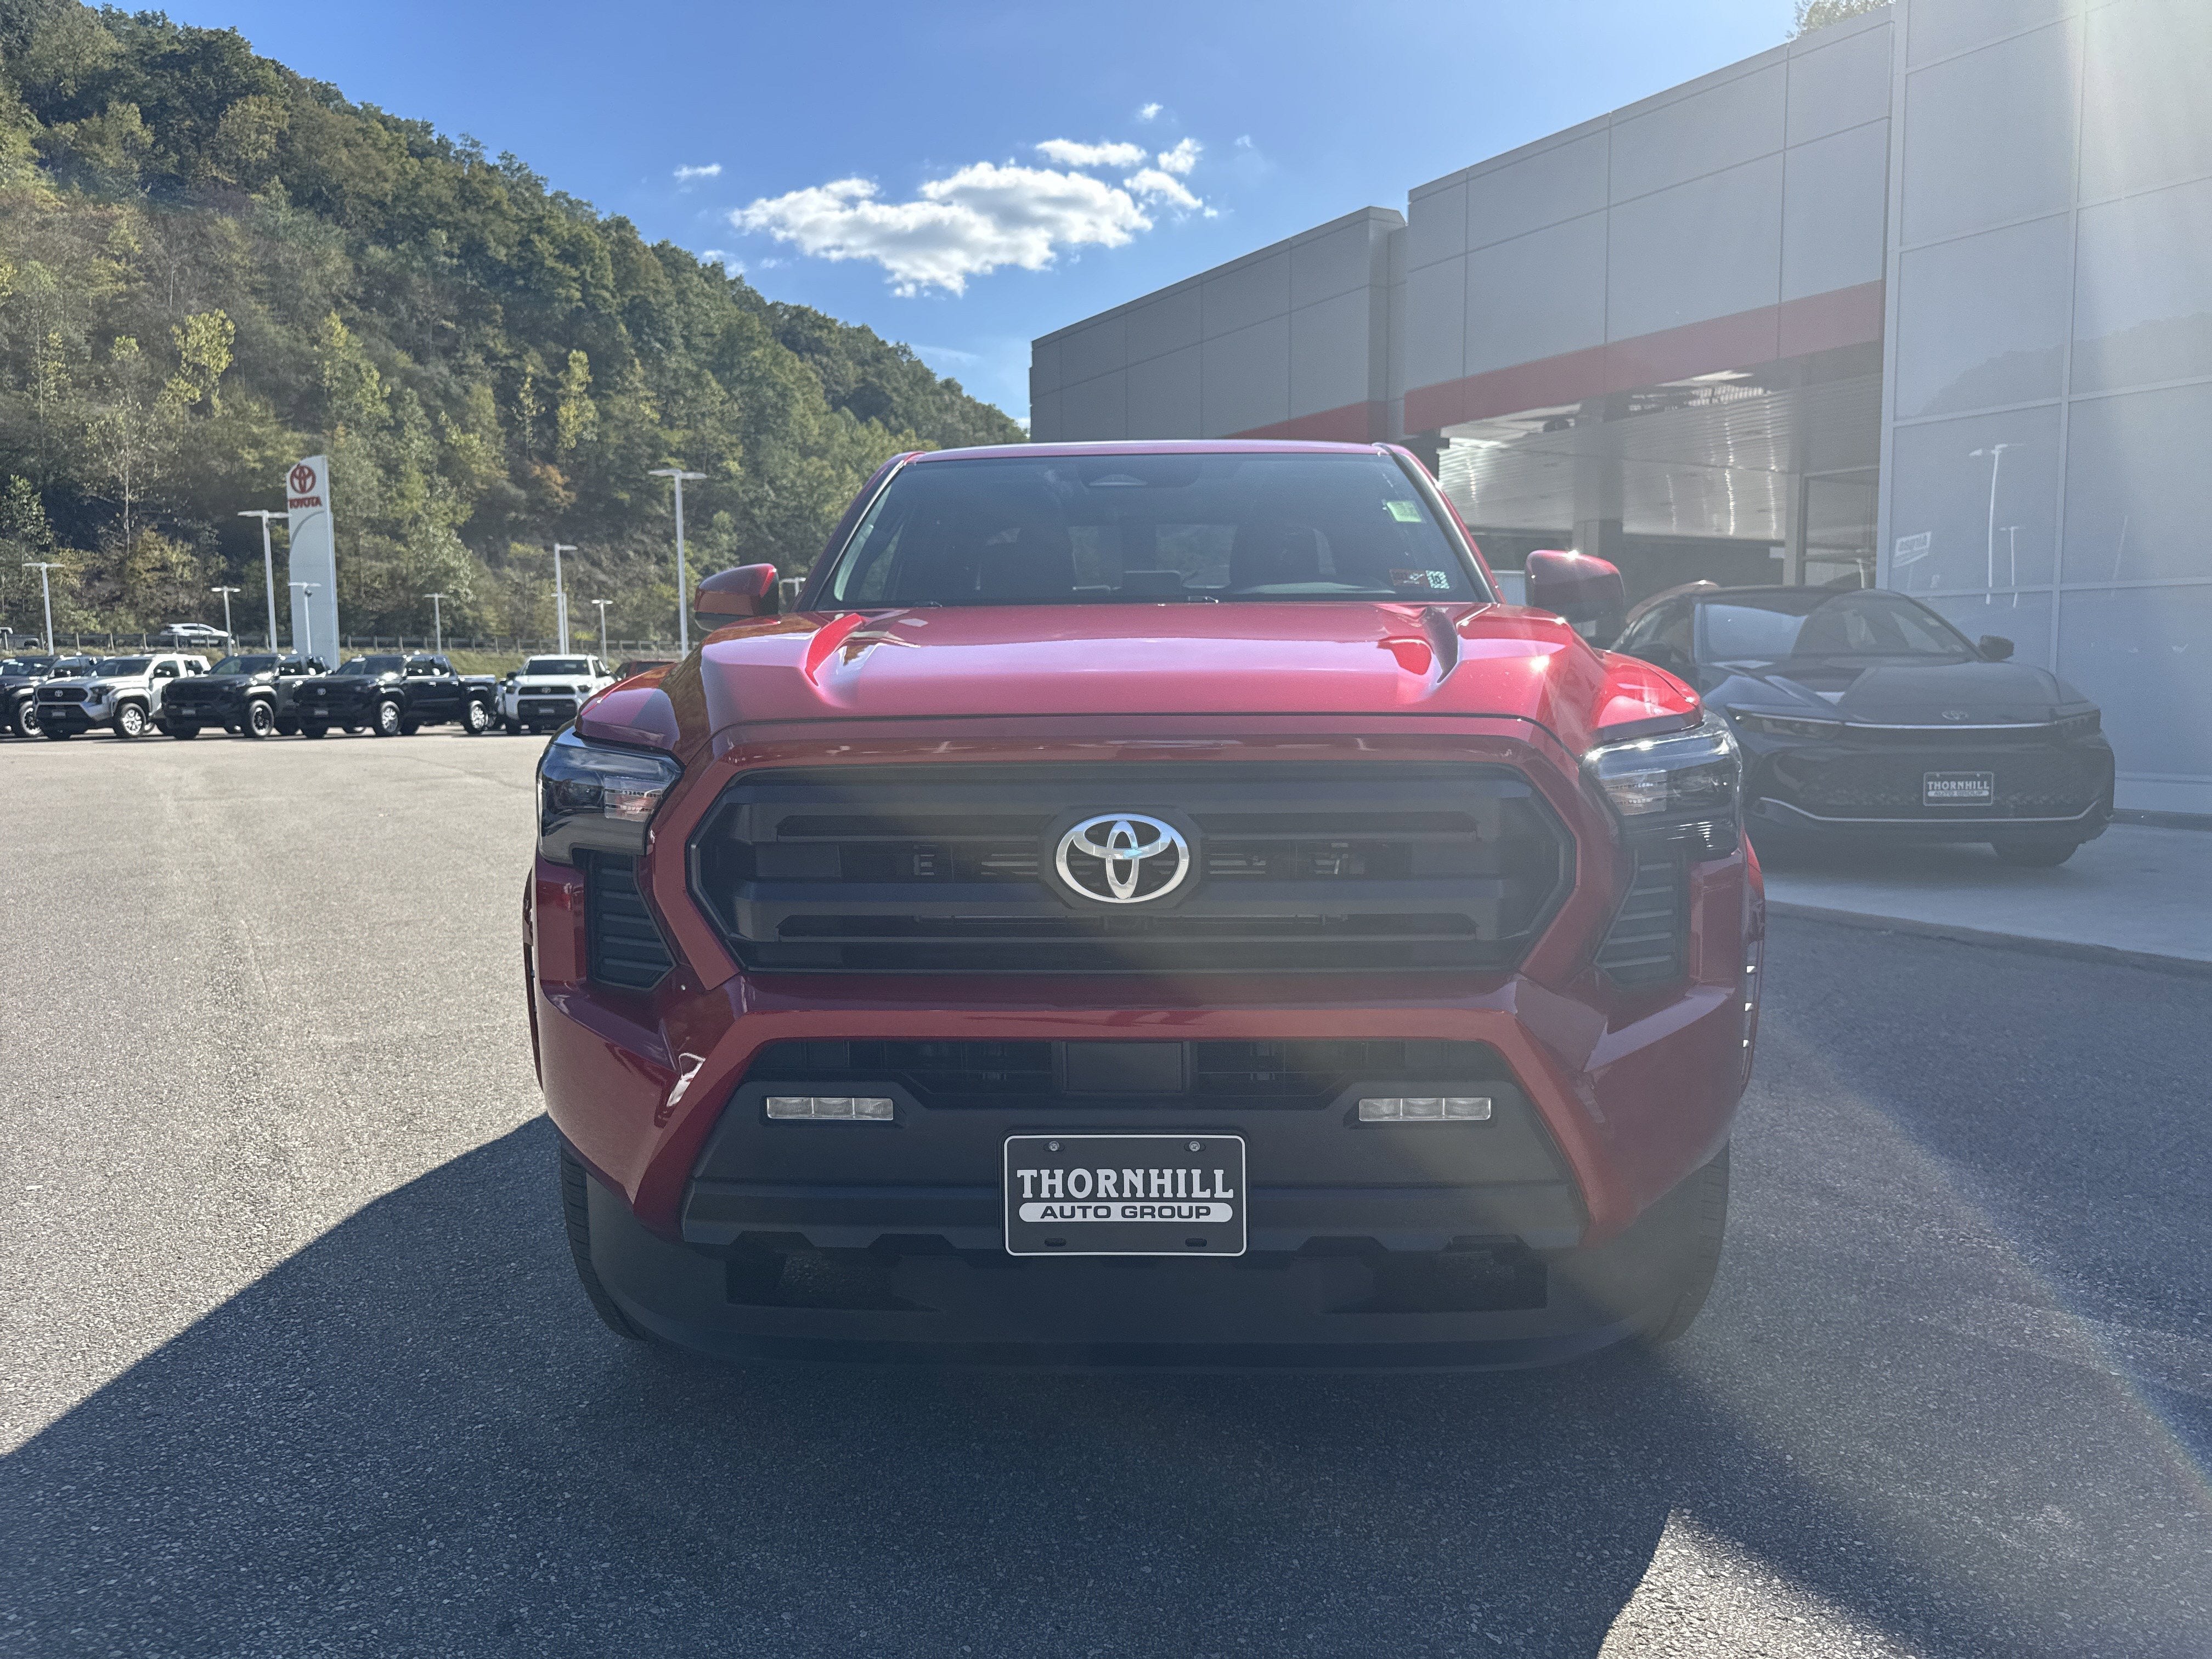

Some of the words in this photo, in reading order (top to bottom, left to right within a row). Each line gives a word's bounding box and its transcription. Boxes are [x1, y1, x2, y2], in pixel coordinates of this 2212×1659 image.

[290, 496, 321, 509] TOYOTA
[1927, 781, 1989, 790] THORNHILL
[1017, 1168, 1233, 1198] THORNHILL
[1040, 1205, 1111, 1219] AUTO
[1121, 1205, 1211, 1219] GROUP
